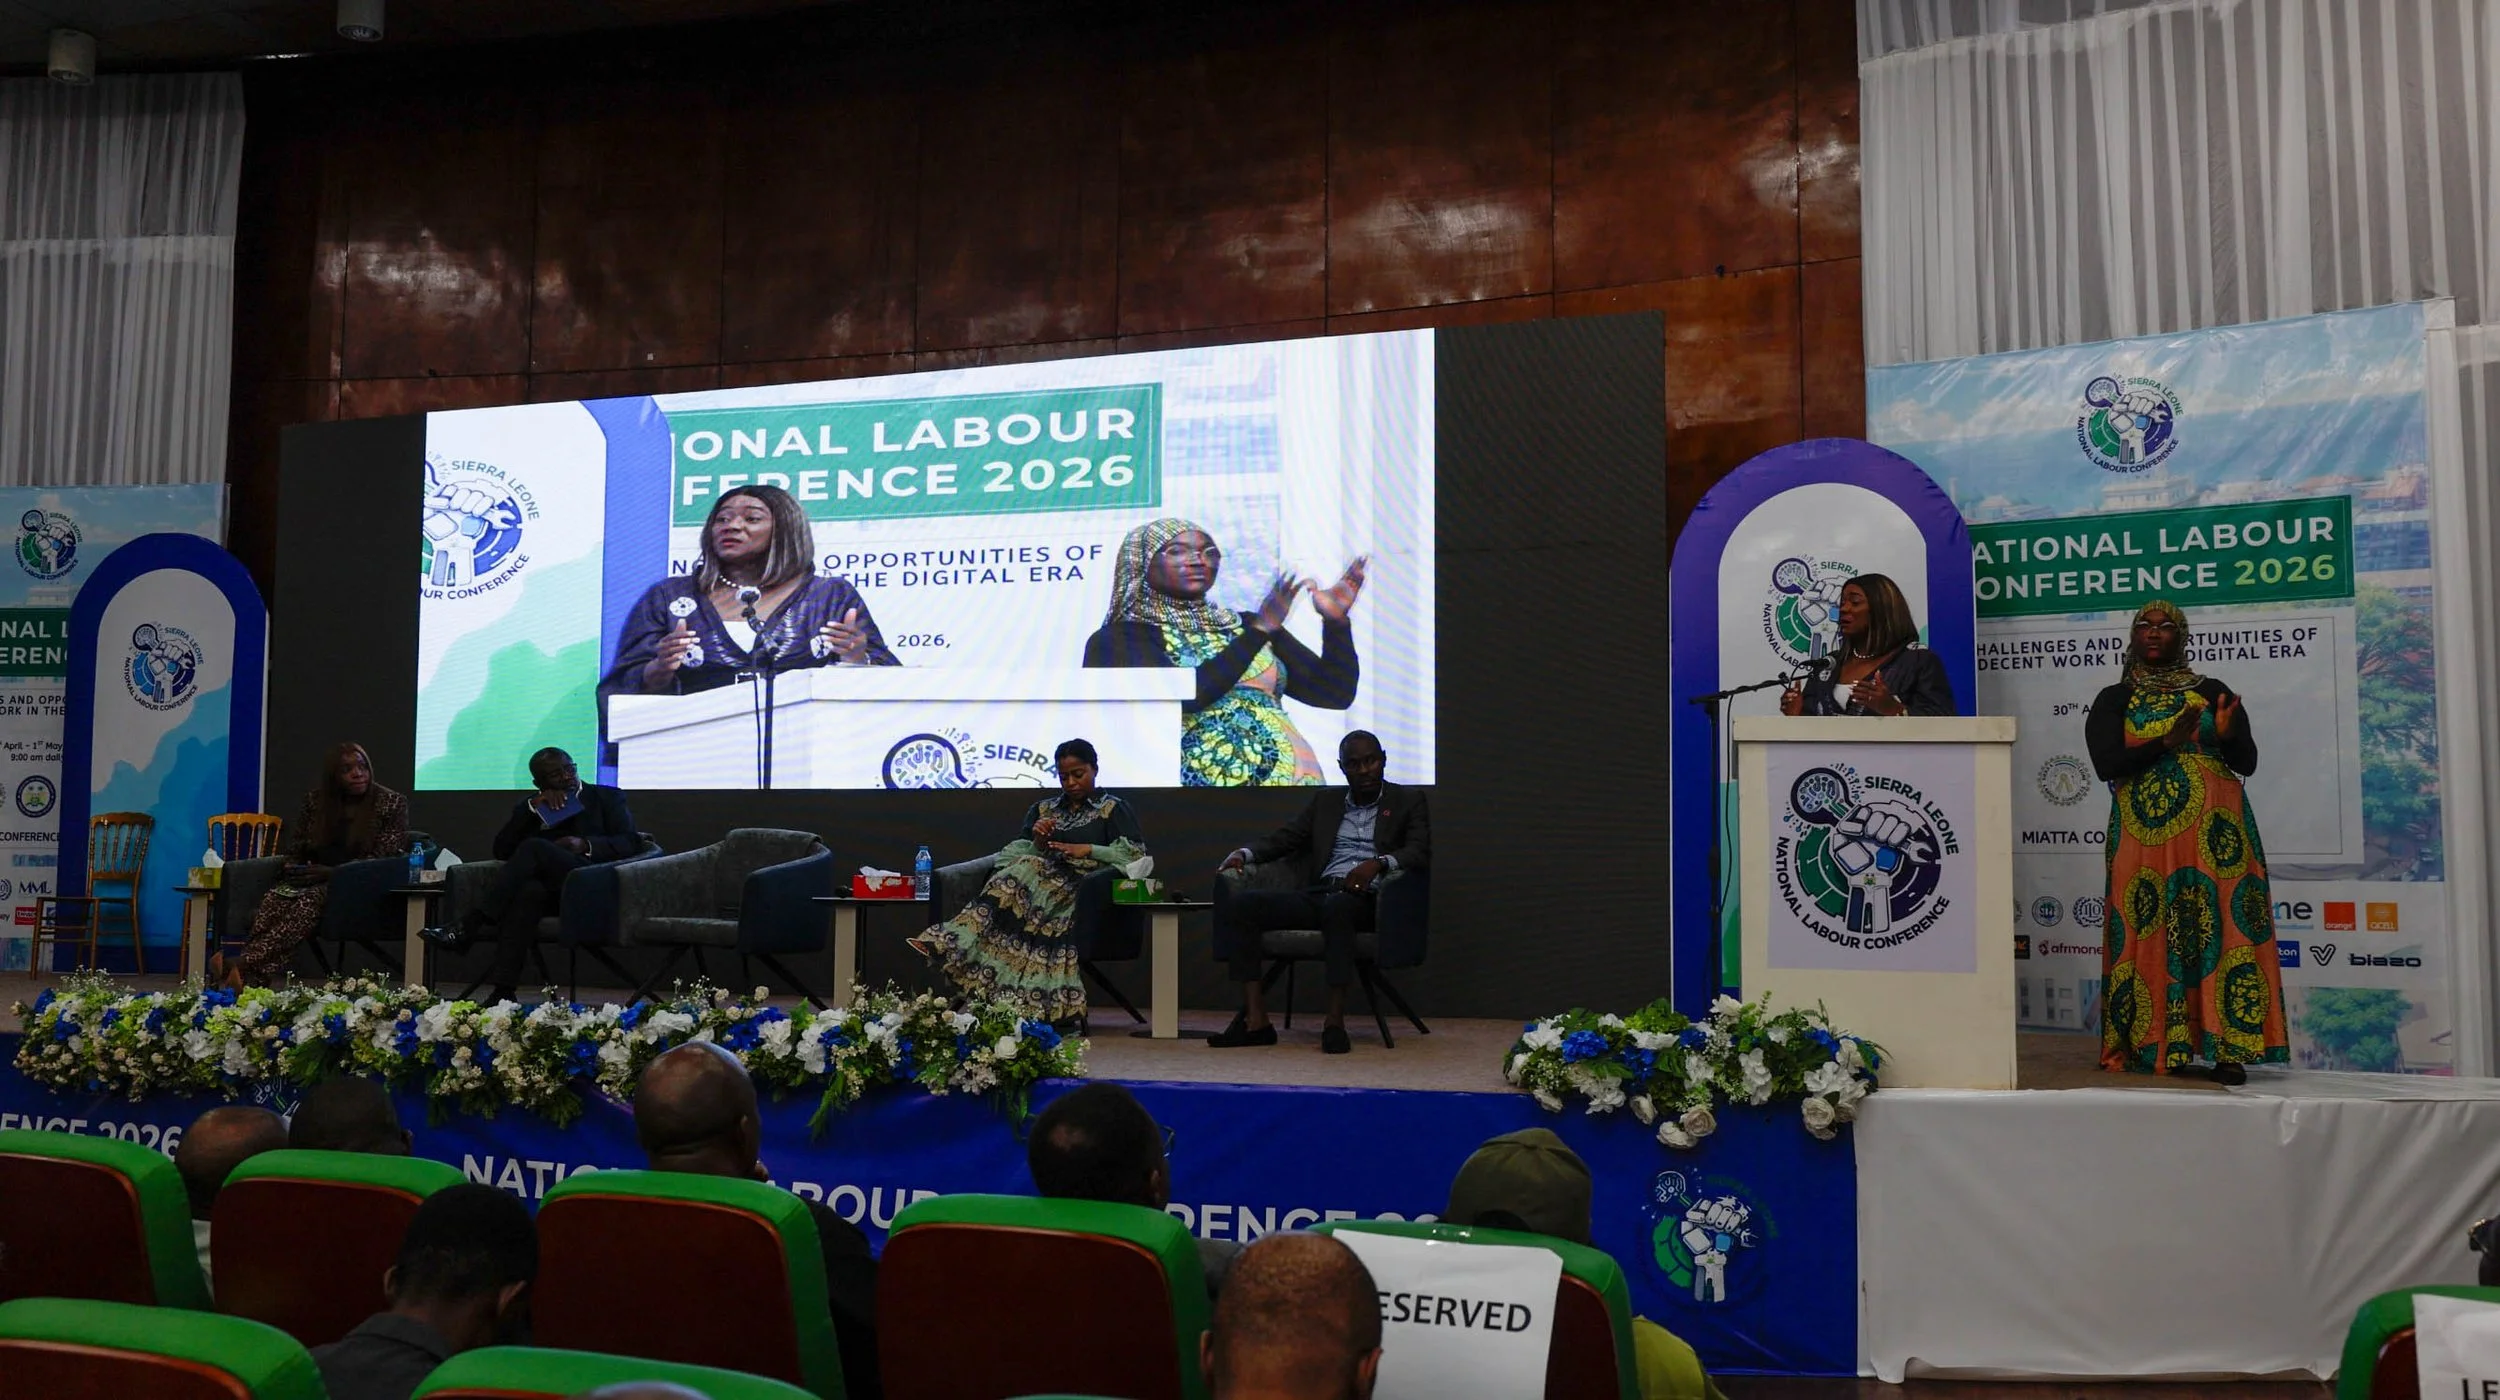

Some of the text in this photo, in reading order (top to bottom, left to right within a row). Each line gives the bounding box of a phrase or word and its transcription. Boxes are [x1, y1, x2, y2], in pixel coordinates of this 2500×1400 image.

[2127, 378, 2184, 416] SIERRA LEONE
[682, 408, 1135, 462] ONAL LABOUR
[2077, 416, 2179, 473] NATIONAL LABOUR CONFERENCE
[982, 454, 1134, 493] 2026
[452, 460, 540, 521] SIERRA LEONE
[1975, 517, 2335, 565] ATIONAL LABOUR
[824, 547, 1049, 570] OPPORTUNITIES
[1066, 545, 1103, 561] OF
[1820, 561, 1858, 576] SIERRA
[421, 553, 530, 600] UR CONFERENCE
[903, 569, 1014, 586] DIGITAL
[1029, 565, 1083, 582] ERA
[1976, 554, 2335, 601] ONFERENCE 2026
[1, 620, 51, 638] NAL
[897, 634, 951, 649] 2026,
[1763, 603, 1780, 655] NATIONAL
[2085, 638, 2123, 651] AND
[2292, 628, 2317, 641] OF
[164, 627, 204, 665] SIERRA LEONE
[1978, 656, 2044, 671] DECENT
[2052, 653, 2106, 668] WORK
[2185, 647, 2260, 662] DIGITAL
[2270, 645, 2306, 658] ERA
[124, 657, 198, 711] NATIONAL LABOUR CONFERENCE
[9, 695, 34, 705] AND
[27, 706, 39, 715] IN
[44, 706, 65, 715] THE
[2053, 703, 2079, 716] 30TH
[4, 742, 23, 751] April
[11, 753, 28, 761] 9:00
[984, 744, 1059, 778] SIERRA
[1865, 776, 1960, 855] SIERRA LEONE
[2022, 831, 2079, 844] MIATTA
[1775, 836, 1950, 950] NATIONAL LABOUR CONFERENCE
[2084, 902, 2101, 918] ILO
[2326, 923, 2353, 931] orange
